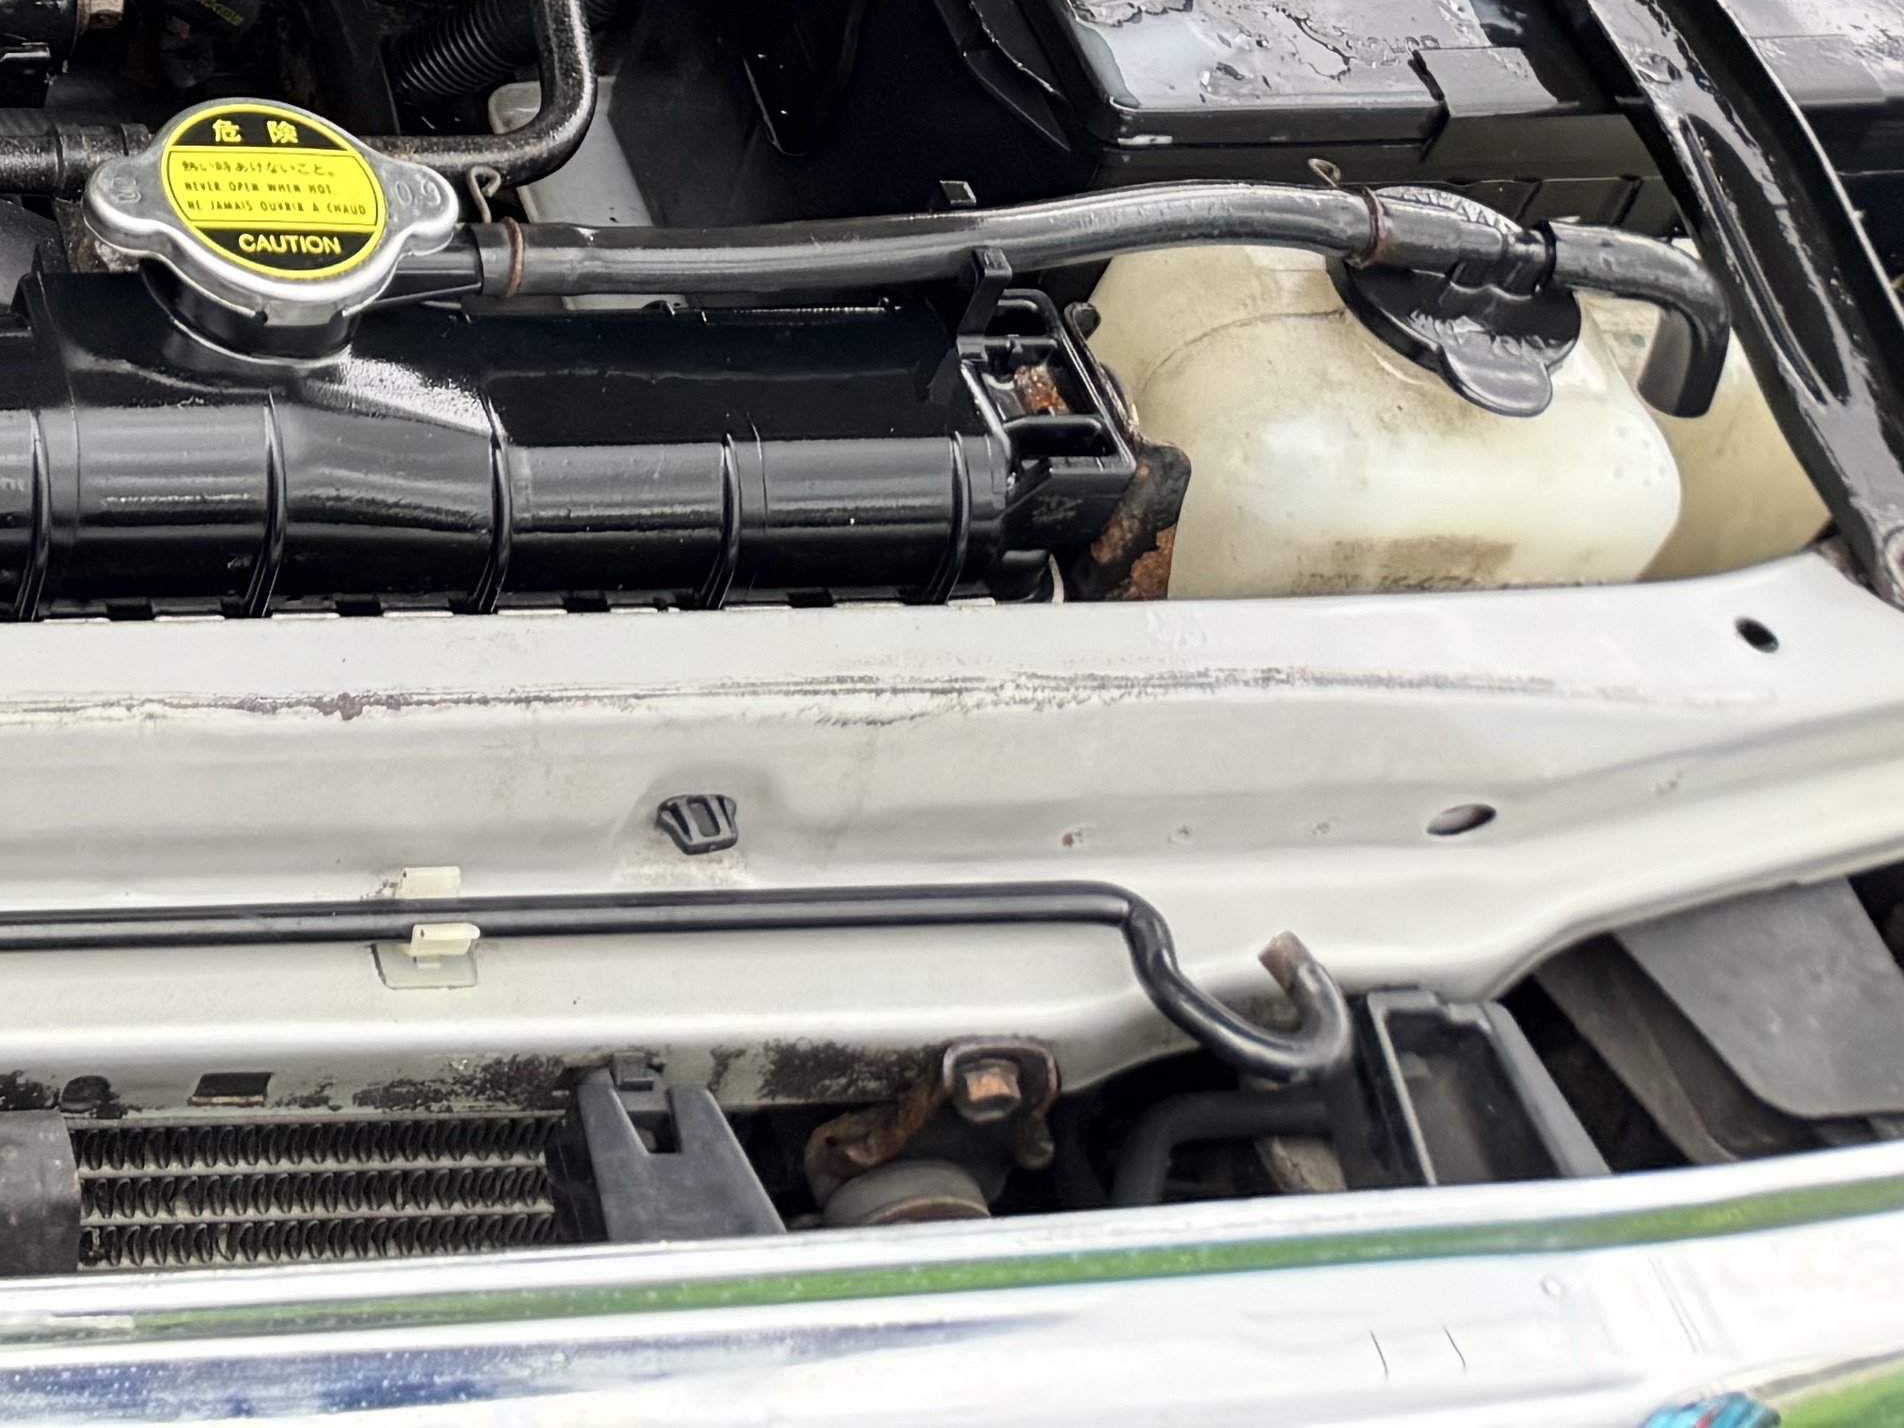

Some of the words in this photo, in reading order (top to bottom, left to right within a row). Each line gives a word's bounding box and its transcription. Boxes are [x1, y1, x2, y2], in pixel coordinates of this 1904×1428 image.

[212, 118, 299, 144] 危険
[184, 180, 221, 193] NEVER
[228, 181, 260, 193] OPEN
[267, 182, 302, 194] WHEN
[187, 199, 203, 211] NE
[210, 199, 254, 212] JAMAIS
[260, 201, 305, 213] OUVRIR
[325, 203, 367, 216] CHAUD
[238, 233, 342, 255] CAUTION
